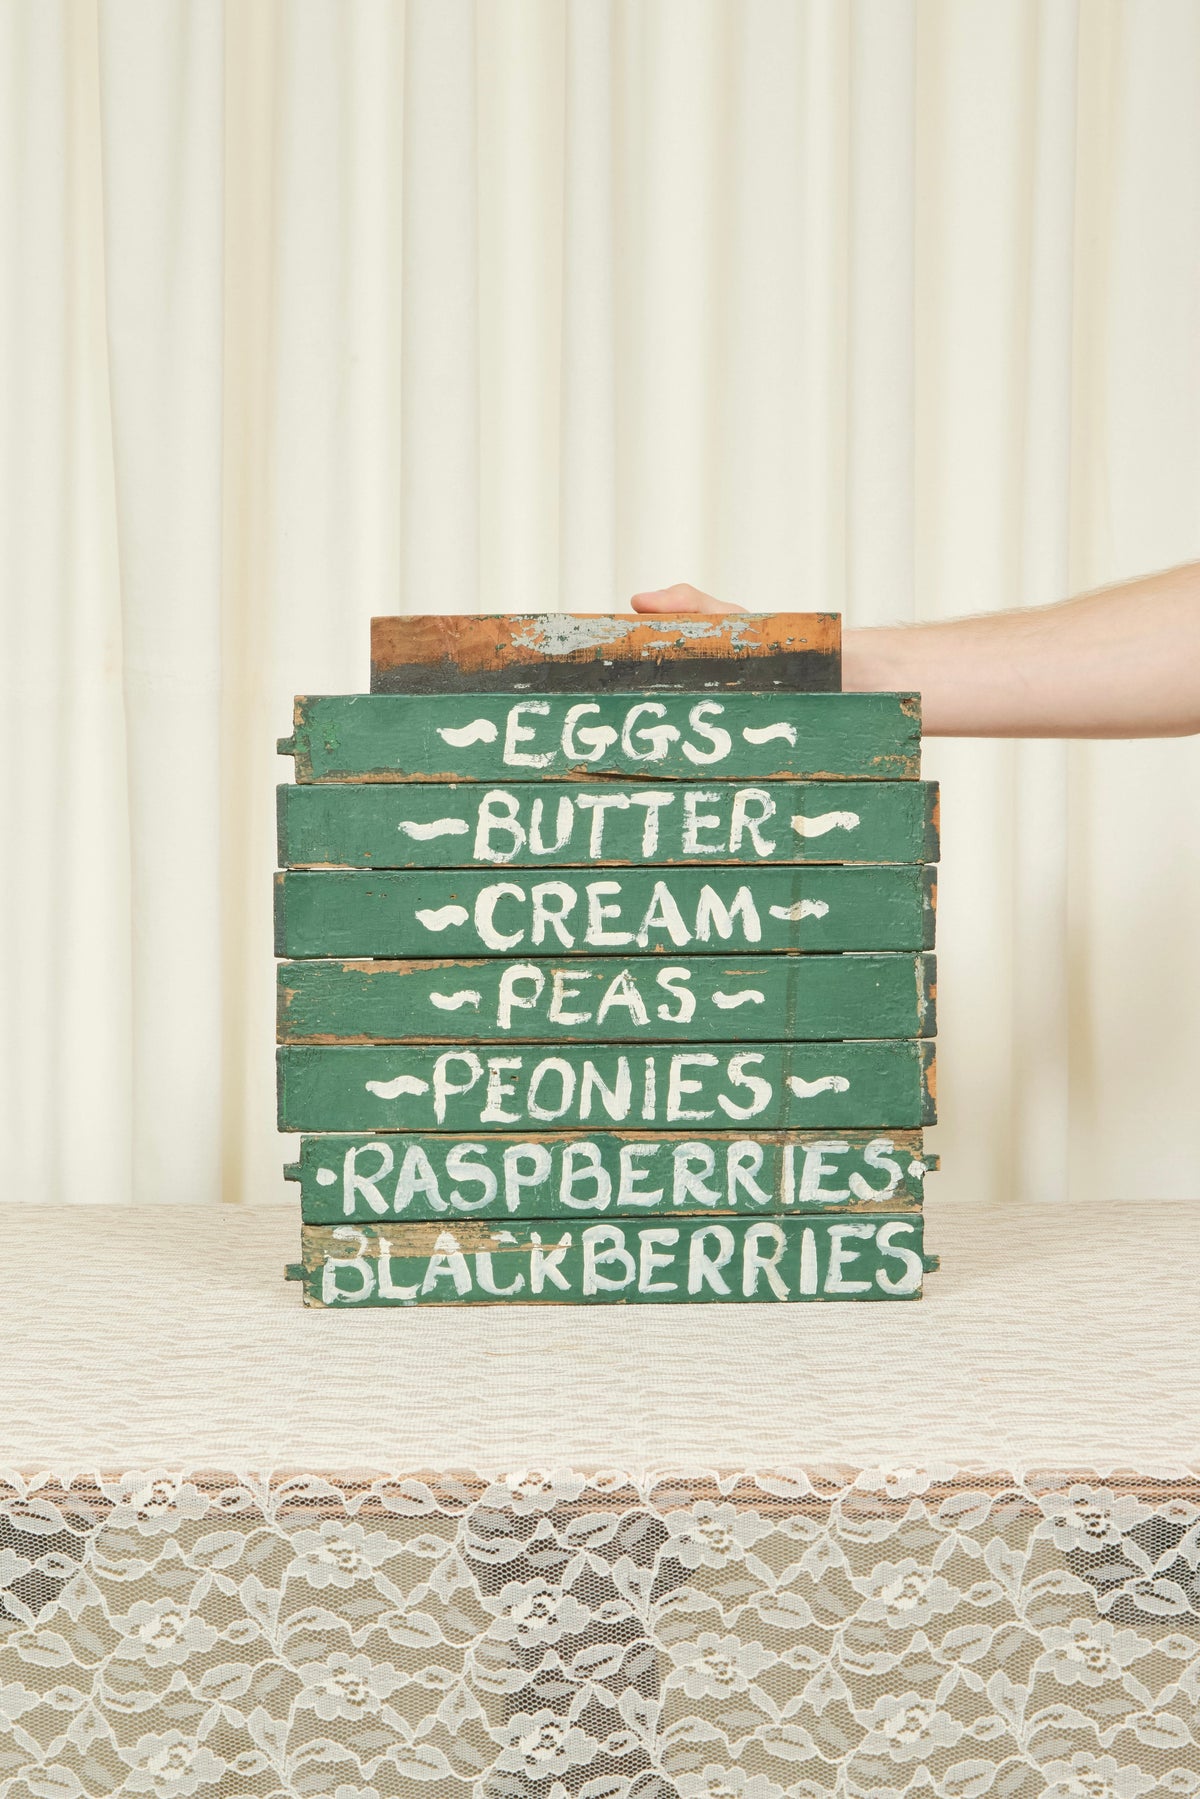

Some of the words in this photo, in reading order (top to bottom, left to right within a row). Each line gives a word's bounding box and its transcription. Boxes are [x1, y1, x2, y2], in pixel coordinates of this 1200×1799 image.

[502, 700, 733, 769] EGGS
[473, 788, 777, 864] BUTTER
[474, 881, 762, 952] CREAM
[496, 963, 697, 1030] PEAS
[432, 1050, 773, 1126] PEONIES
[342, 1138, 906, 1217] RASPBERRIES
[321, 1222, 924, 1307] BLACKBERRIES
